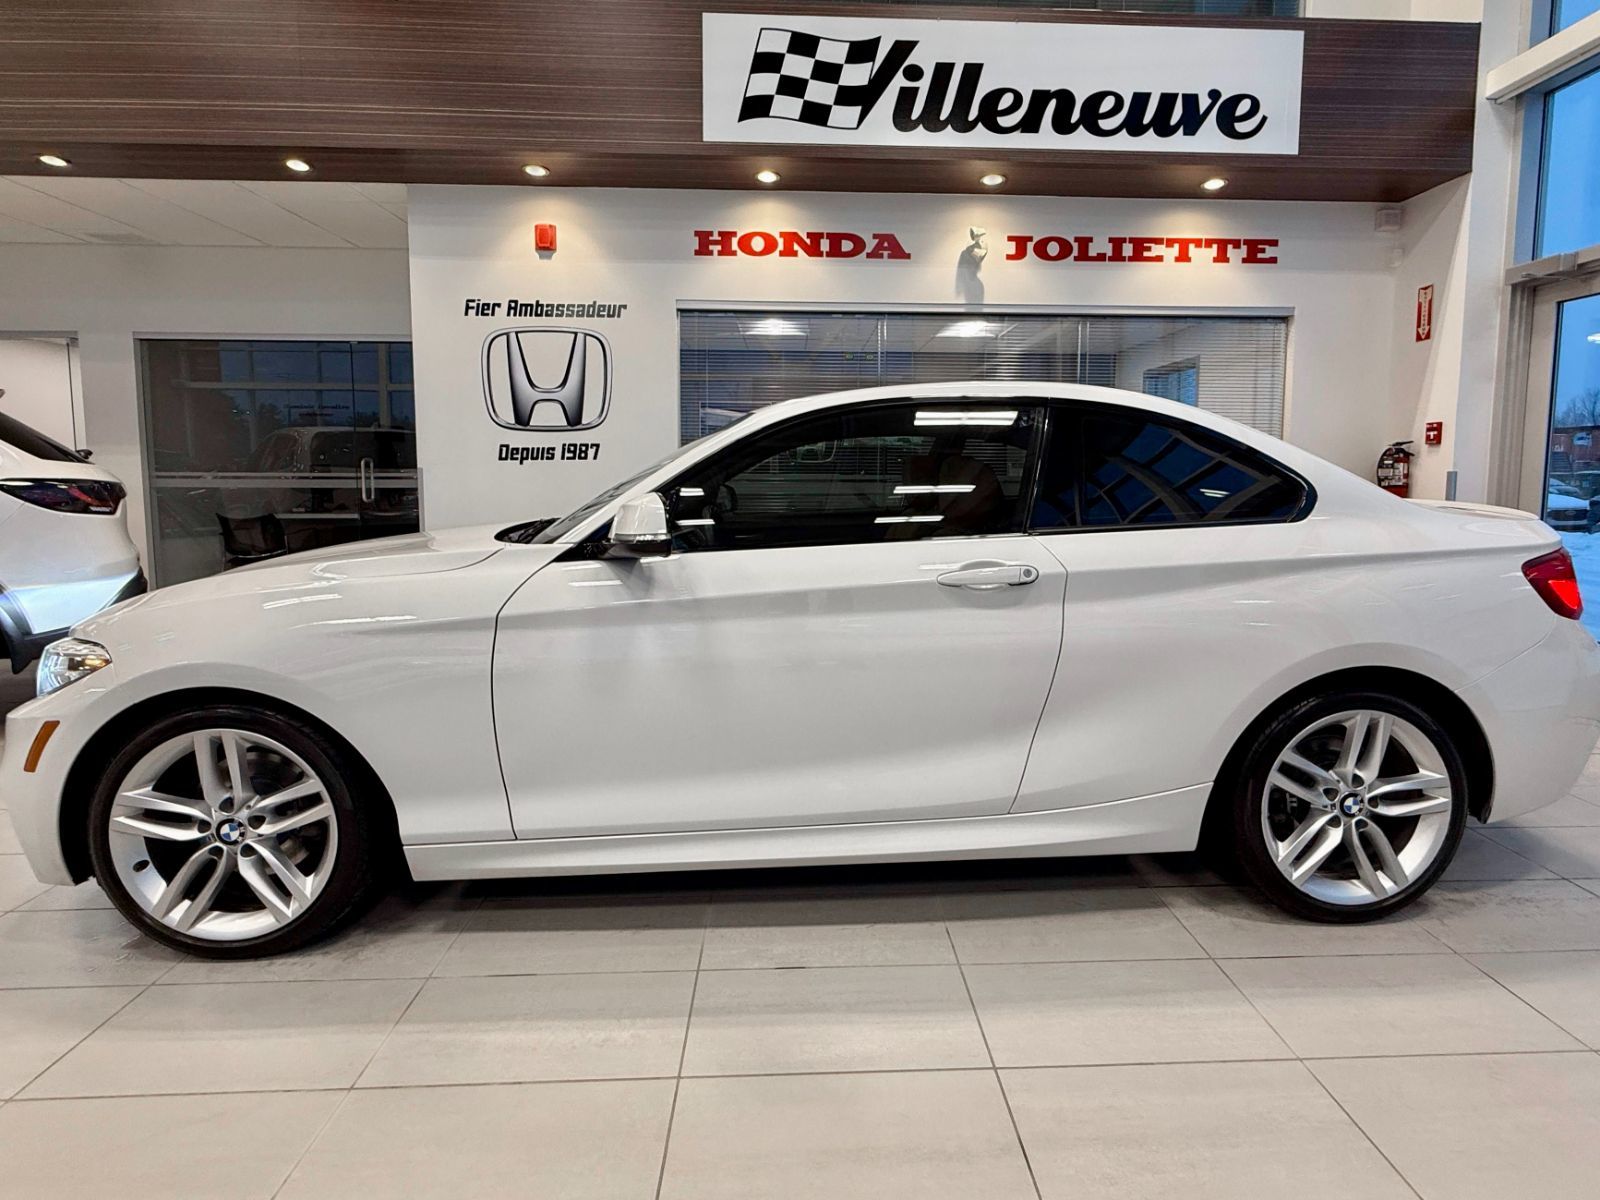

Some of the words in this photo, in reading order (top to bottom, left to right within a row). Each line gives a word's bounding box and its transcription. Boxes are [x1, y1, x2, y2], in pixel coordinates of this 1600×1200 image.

[853, 40, 1268, 141] Villeneuve
[694, 230, 911, 260] HONDA
[1006, 235, 1279, 264] JOLIETTE
[464, 298, 501, 317] Fier
[506, 300, 628, 319] Ambassadeur
[498, 444, 556, 465] Depuis
[561, 443, 601, 461] 1987
